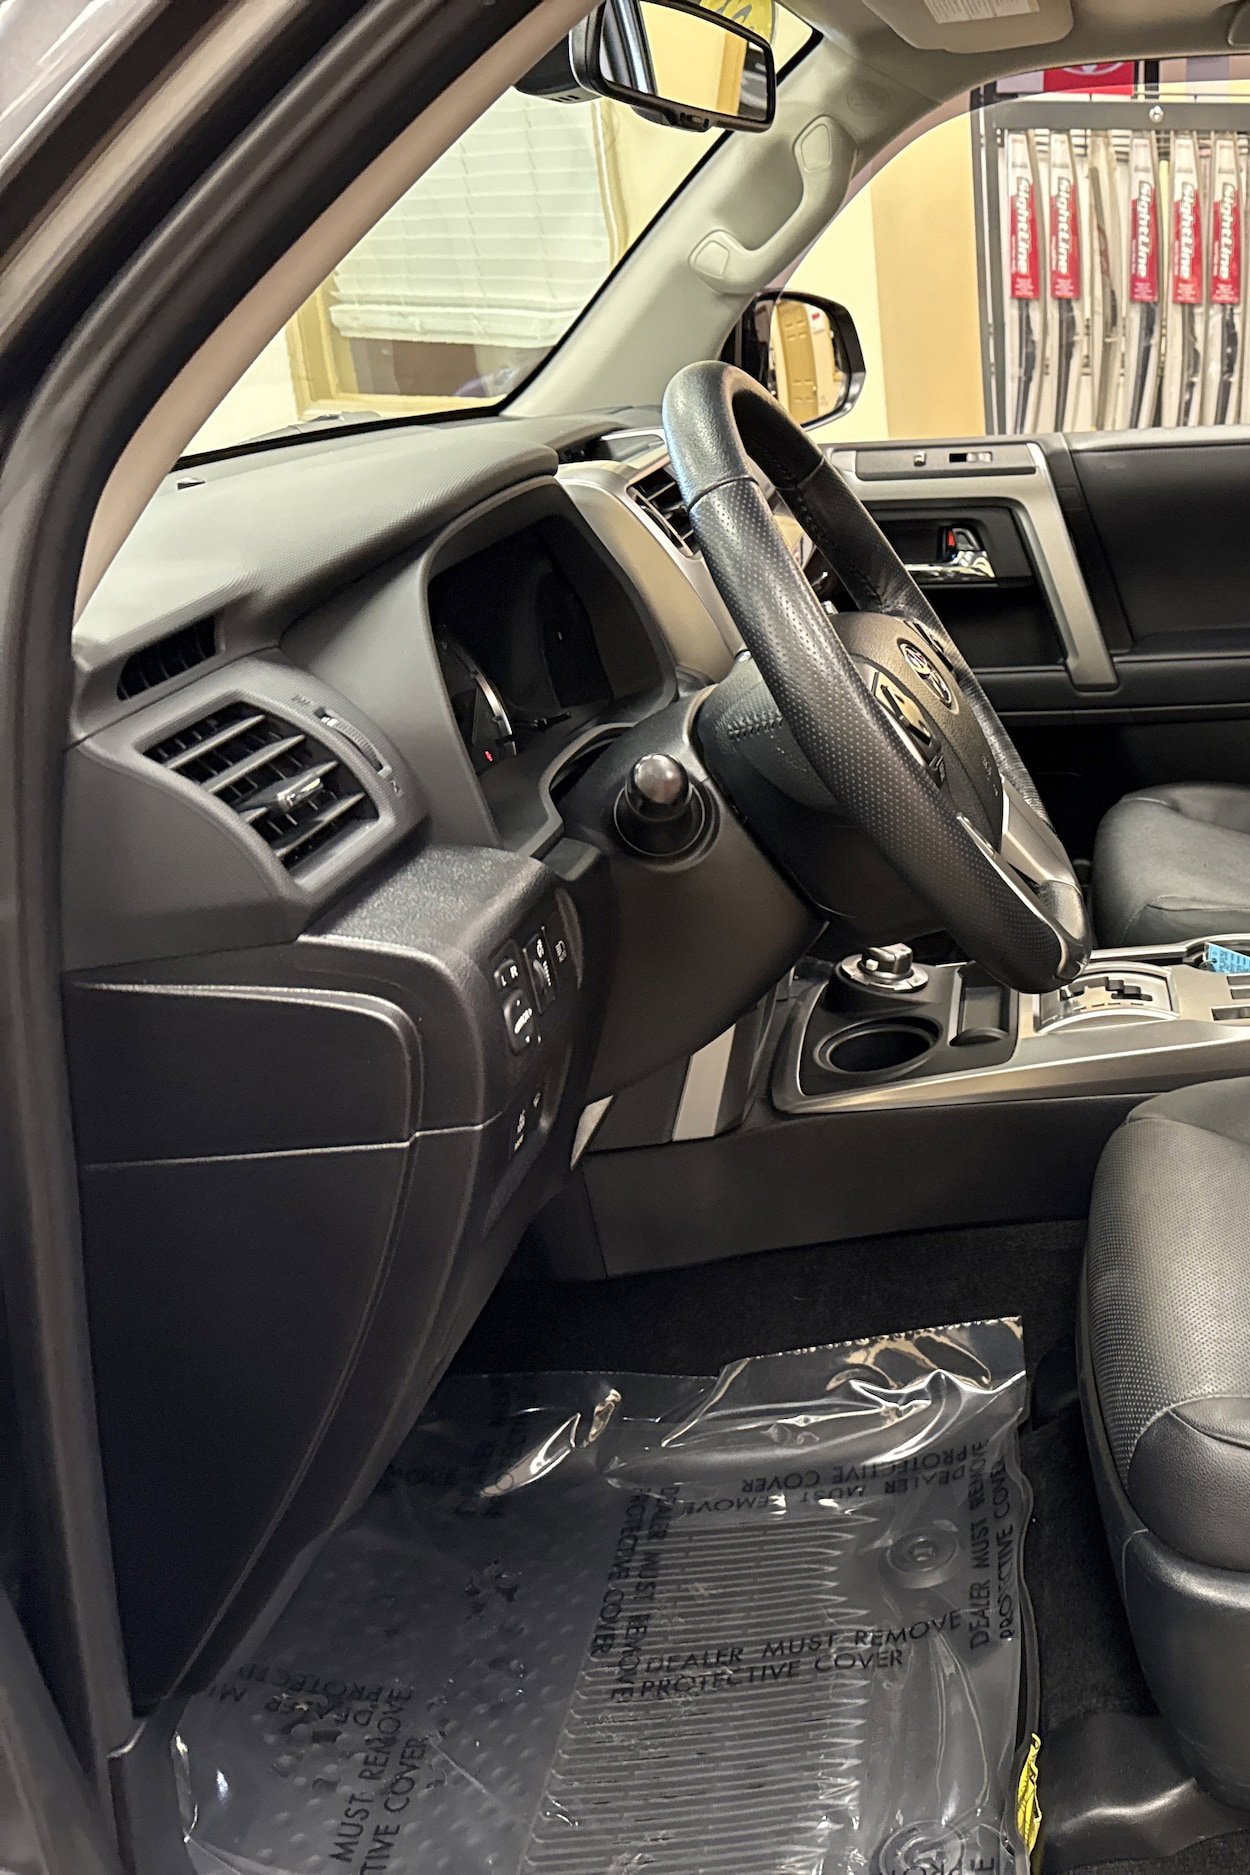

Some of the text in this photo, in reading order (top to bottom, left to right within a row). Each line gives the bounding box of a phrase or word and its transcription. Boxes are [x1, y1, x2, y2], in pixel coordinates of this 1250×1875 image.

[684, 1492, 786, 1516] EMOVE
[741, 1452, 968, 1493] PROTECTIVE COVER
[970, 1516, 990, 1570] MUST
[588, 1589, 624, 1659] COVER
[646, 1609, 962, 1673] DEALER MUST REMOVE
[969, 1579, 990, 1650] DEALER
[641, 1649, 904, 1699] PROTECTIVE COVER
[329, 1793, 376, 1862] MUST
[360, 1736, 430, 1875] TIVE COVER
